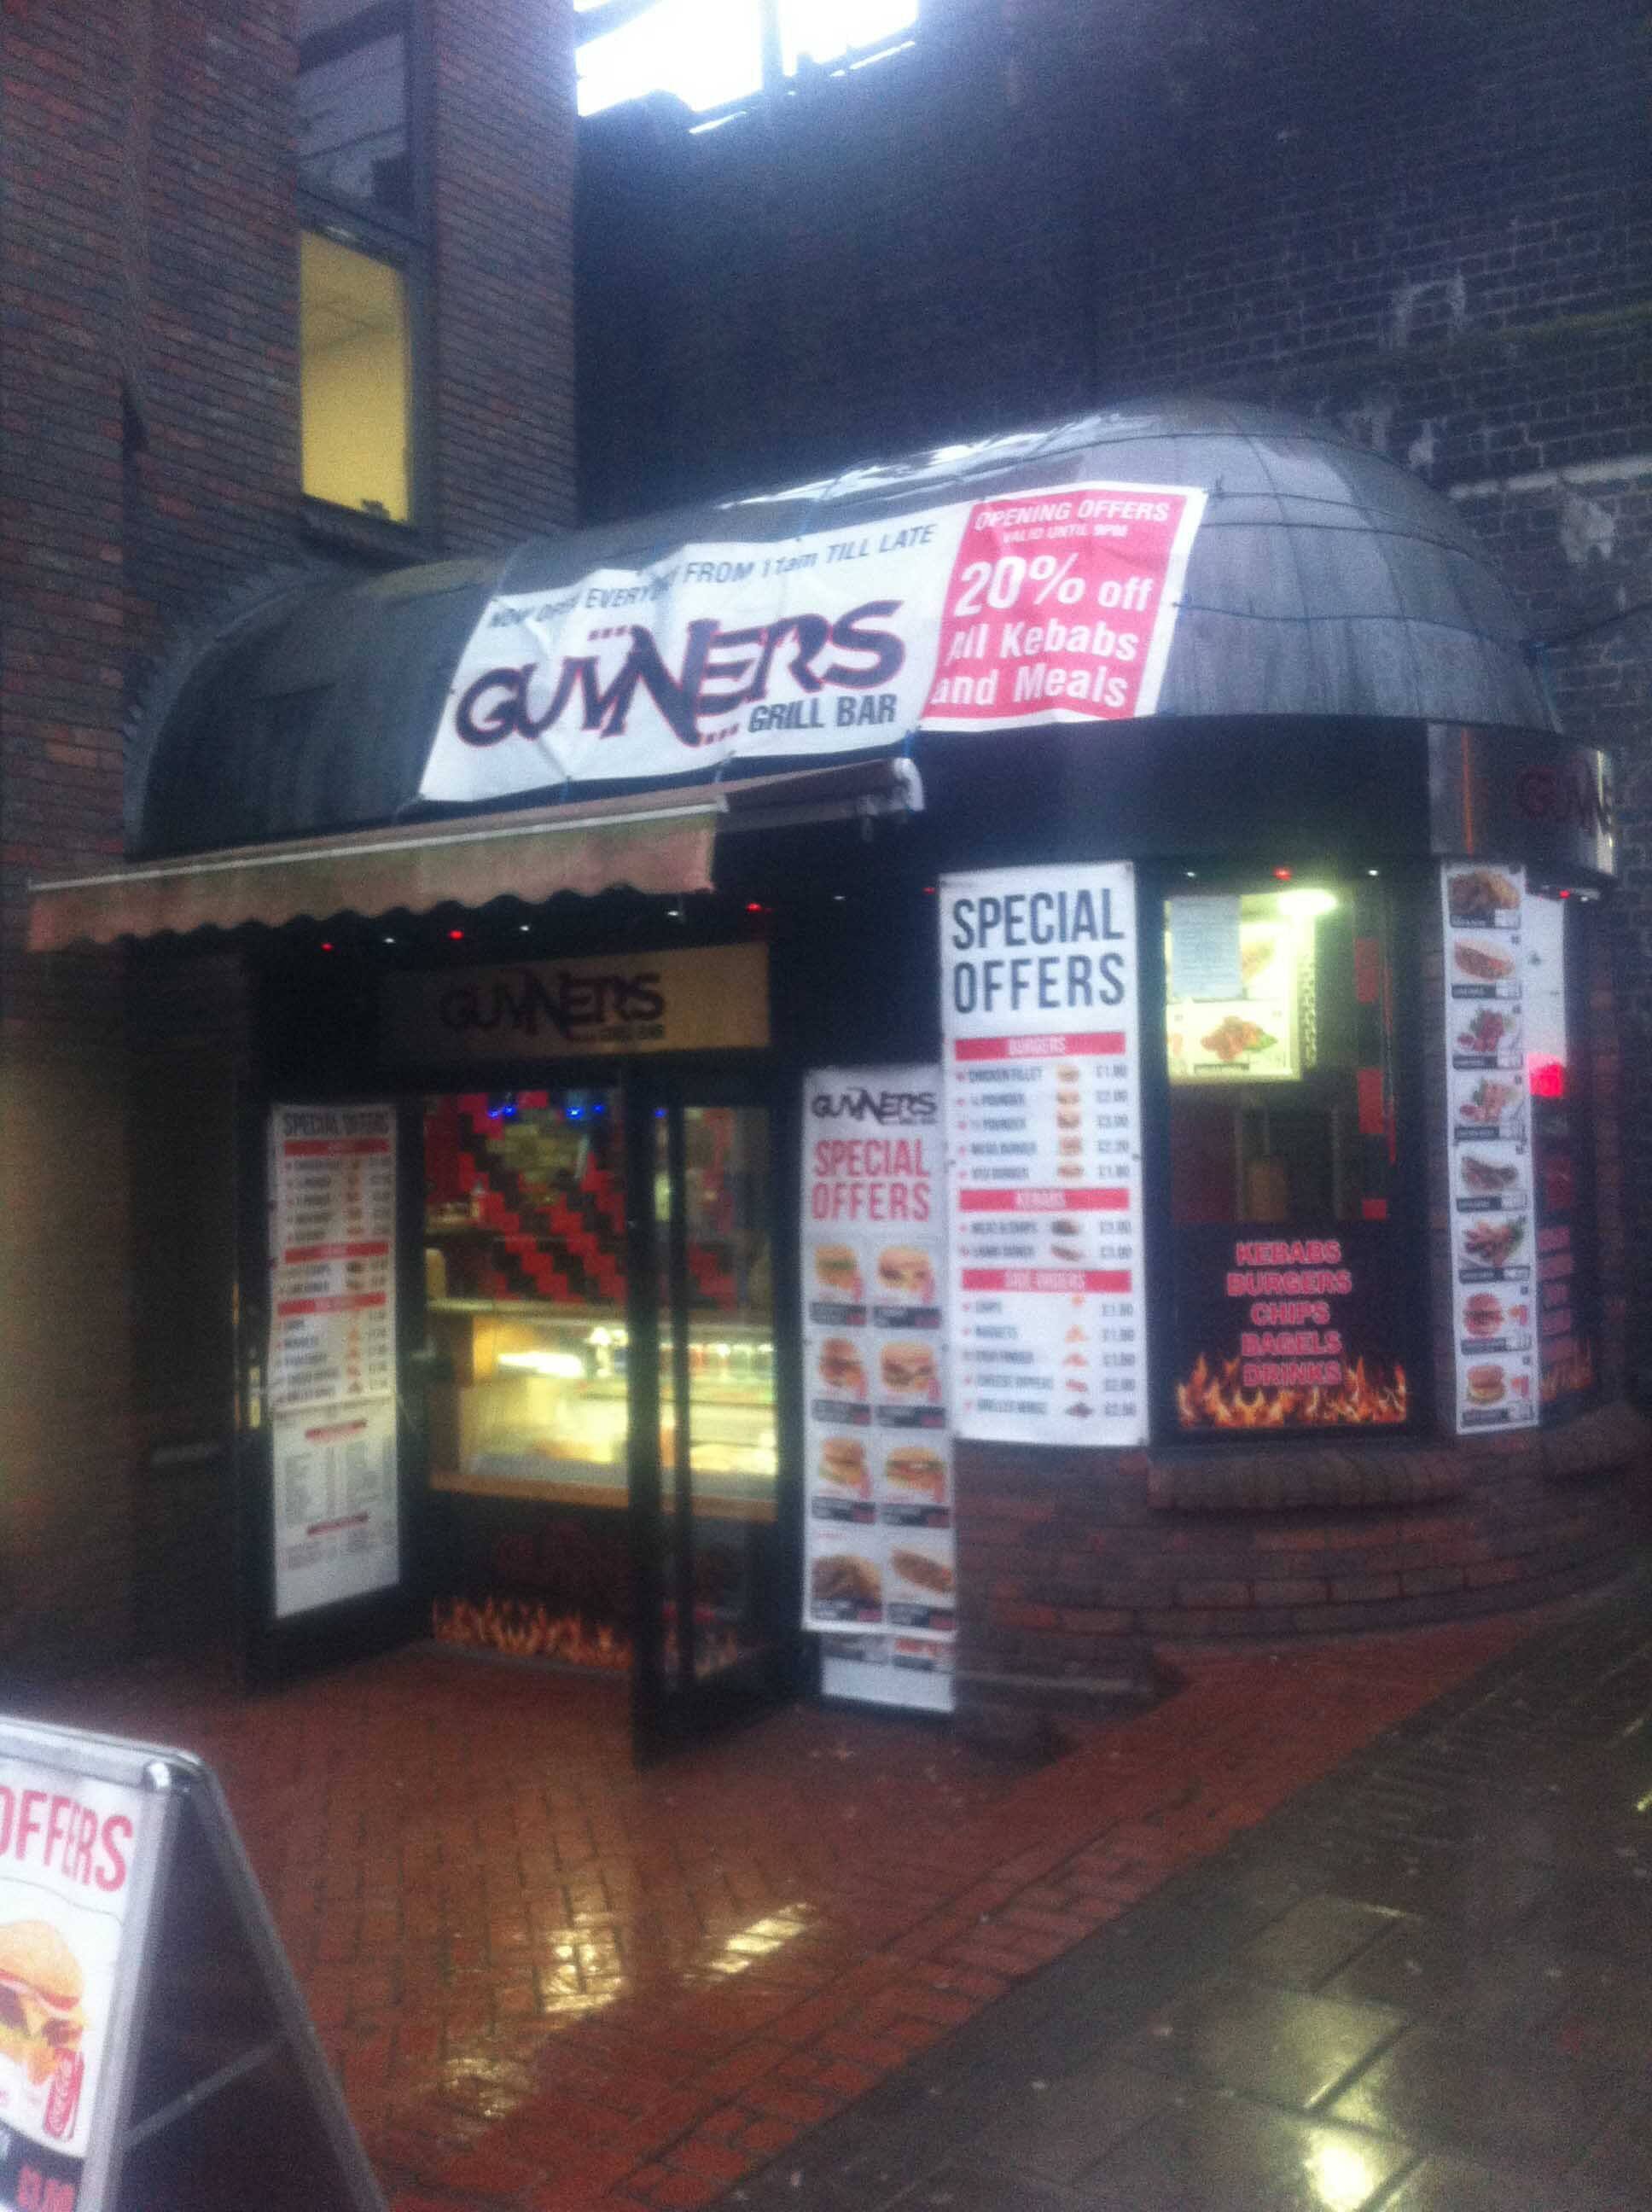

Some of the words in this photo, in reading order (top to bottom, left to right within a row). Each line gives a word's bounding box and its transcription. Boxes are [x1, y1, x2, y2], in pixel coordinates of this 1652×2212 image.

[974, 503, 1071, 531] OPENING
[1078, 498, 1172, 522] OFFERS
[683, 561, 753, 585] FROM
[826, 541, 875, 564] TILL
[878, 524, 937, 554] LATE
[953, 552, 1087, 617] 20%
[1097, 576, 1154, 613] off
[943, 623, 990, 667] All
[1000, 618, 1141, 662] Kebabs
[930, 669, 1000, 707] and
[1013, 662, 1129, 709] Meals
[747, 698, 825, 732] GRILL
[836, 694, 897, 725] BAR
[952, 888, 1126, 950] SPECIAL
[953, 952, 1126, 1014] OFFERS
[814, 1138, 929, 1178] SPECIAL
[813, 1182, 929, 1222] OFFERS
[1236, 1240, 1342, 1265] KEBABS
[1225, 1271, 1352, 1296] BURGERS
[1250, 1301, 1331, 1325] CHIPS
